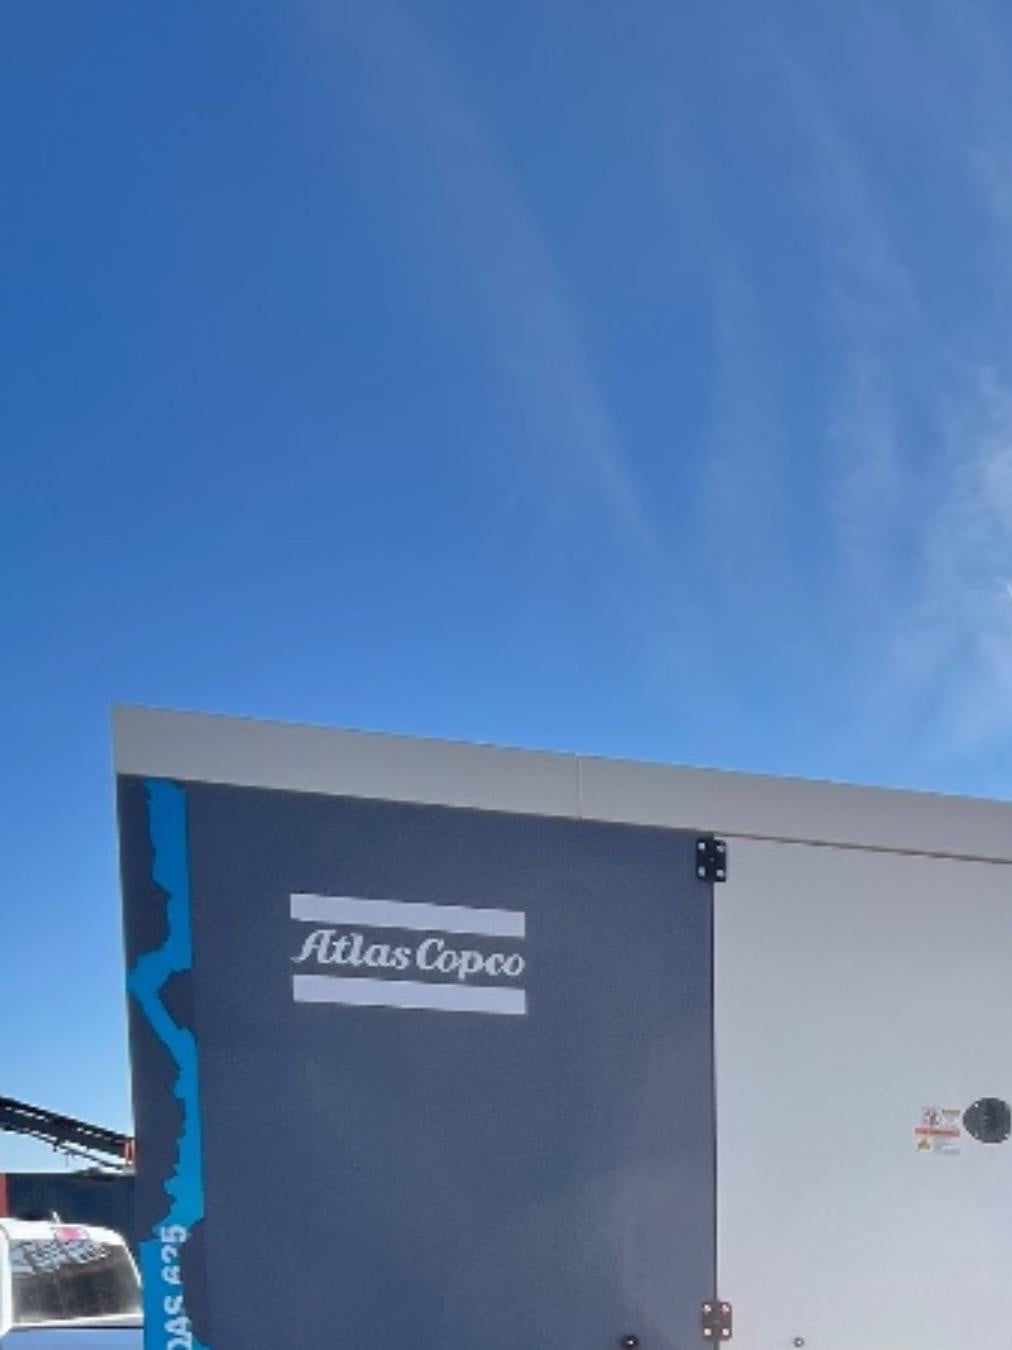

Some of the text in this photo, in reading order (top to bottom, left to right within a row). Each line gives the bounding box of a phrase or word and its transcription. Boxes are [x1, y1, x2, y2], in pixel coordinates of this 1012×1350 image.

[290, 928, 525, 981] Atlas Copco
[160, 1224, 188, 1285] 625
